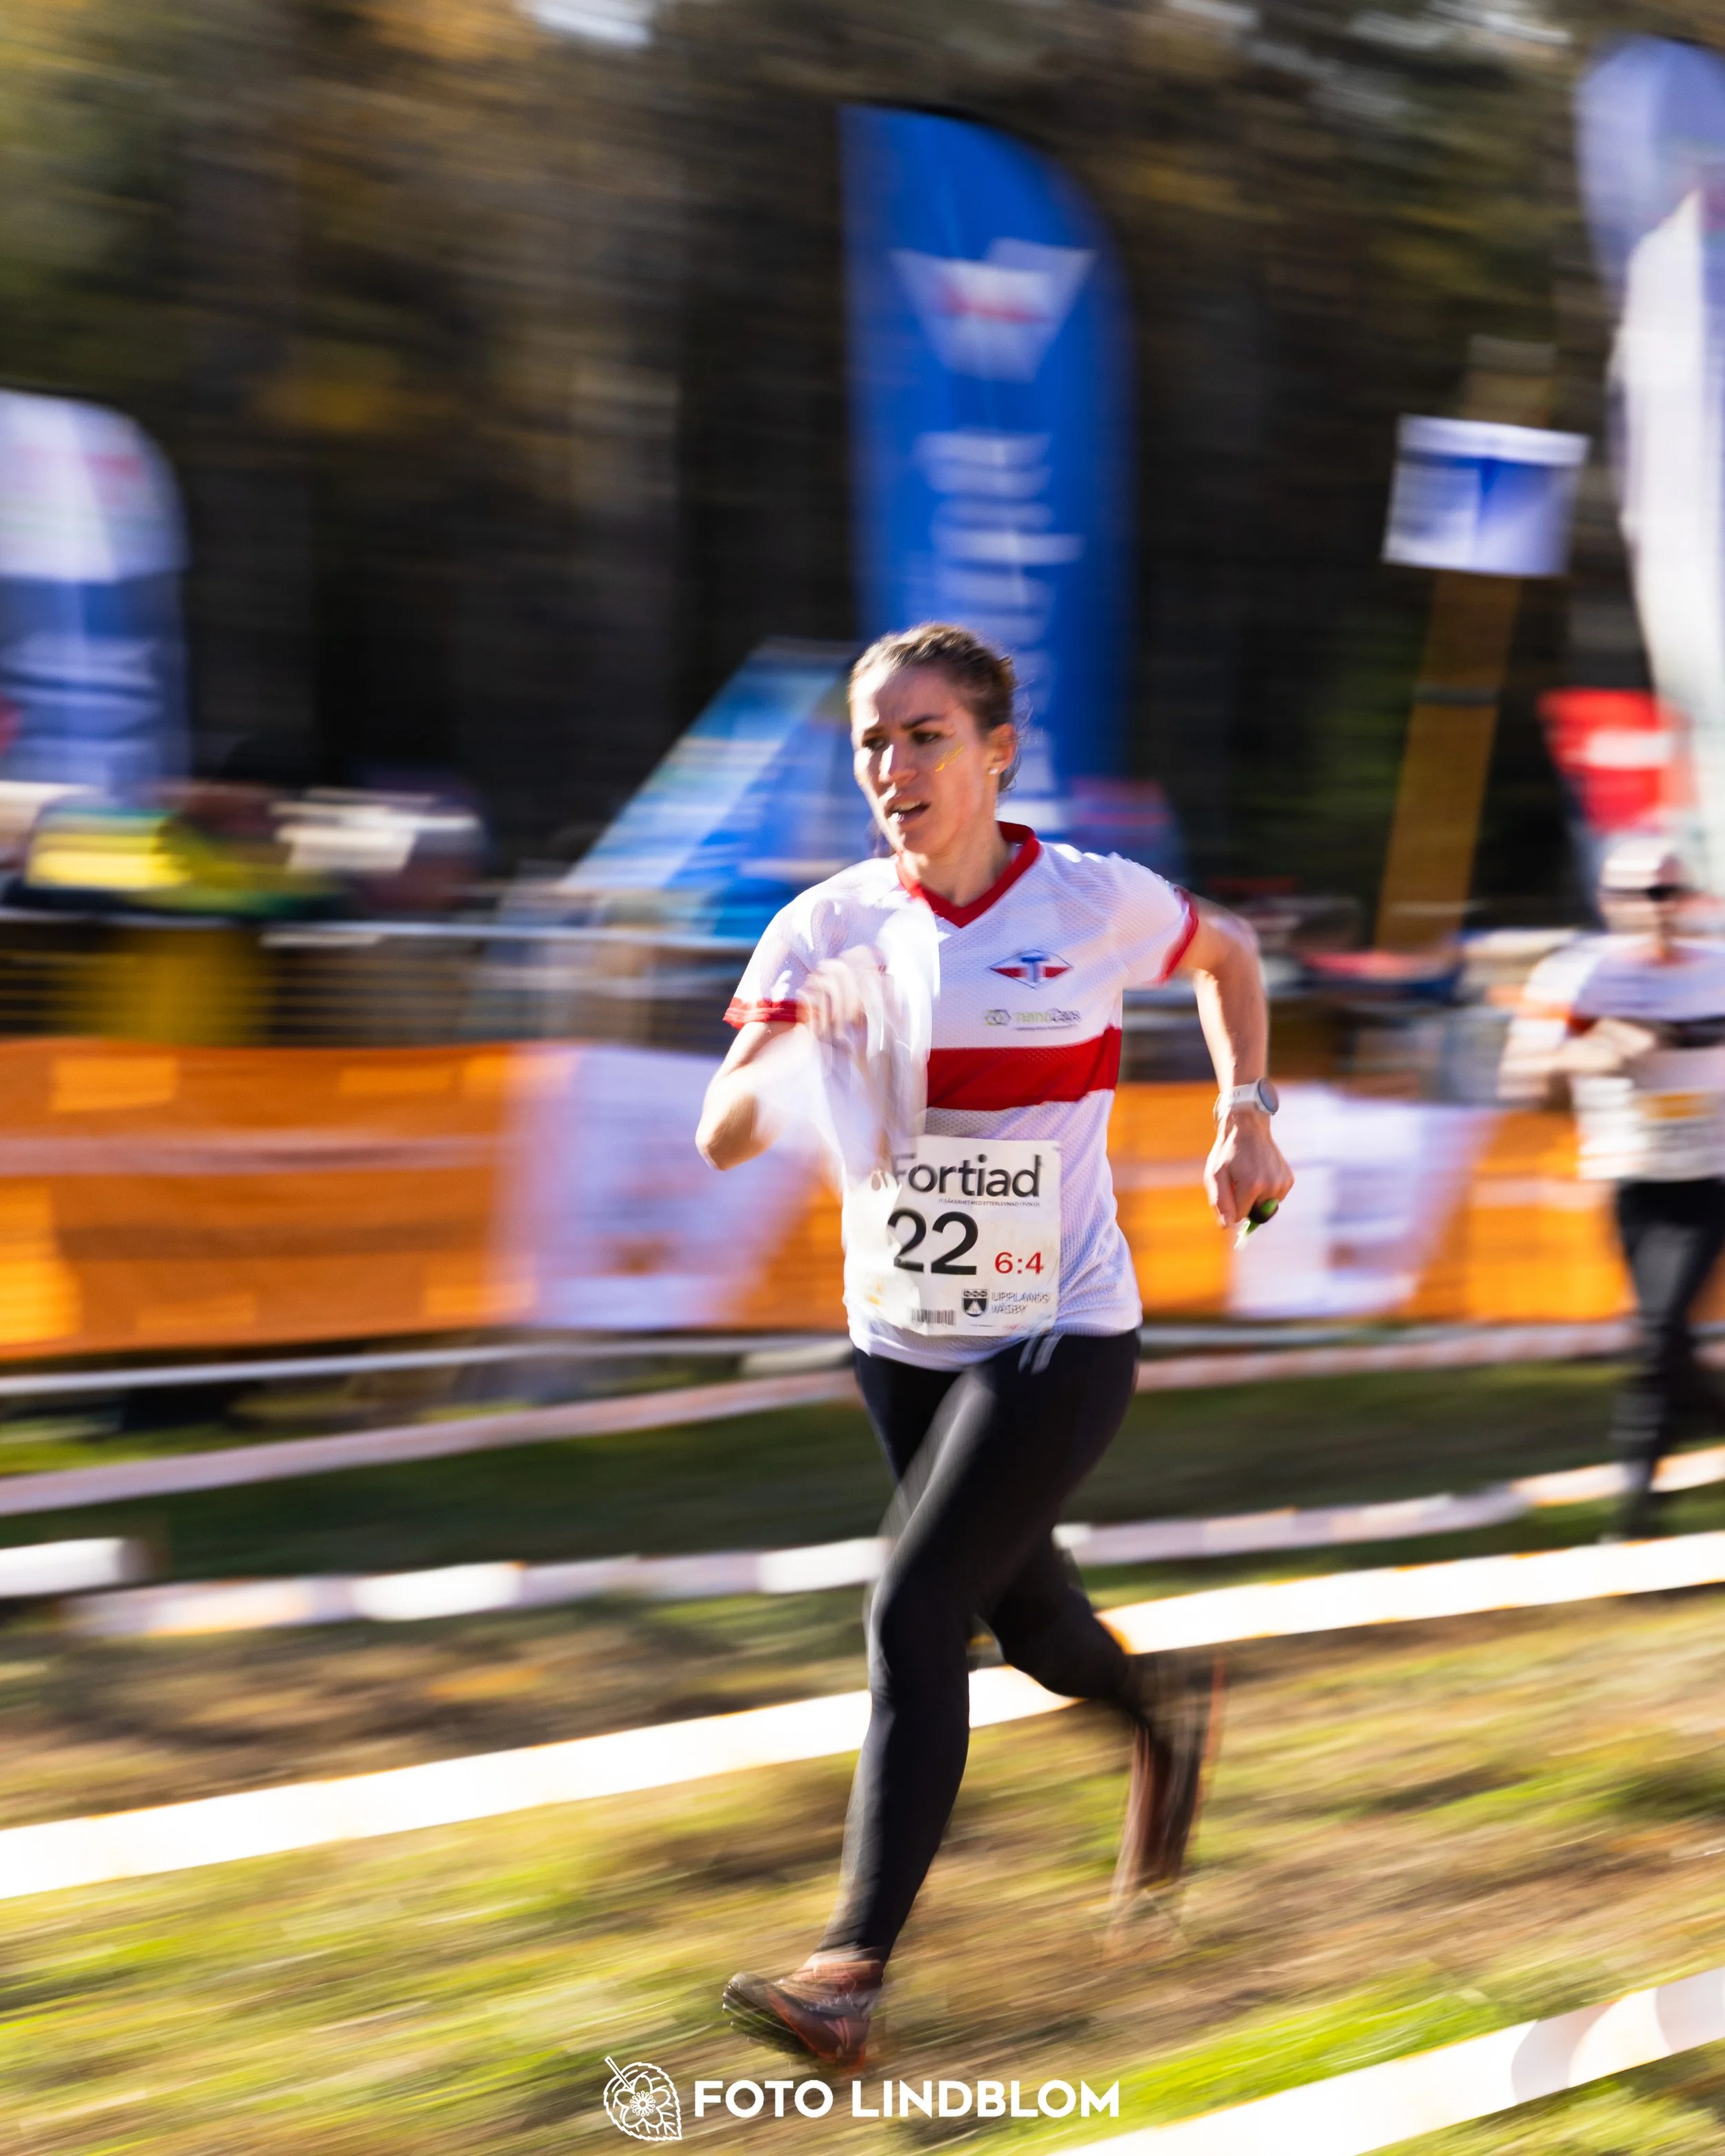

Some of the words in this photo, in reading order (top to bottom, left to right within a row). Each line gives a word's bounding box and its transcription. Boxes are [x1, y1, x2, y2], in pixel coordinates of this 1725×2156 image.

[892, 1152, 1042, 1198] Fortiad
[887, 1208, 978, 1276] 22
[994, 1252, 1044, 1274] 6:4
[992, 1292, 1051, 1304] UPPLANDS
